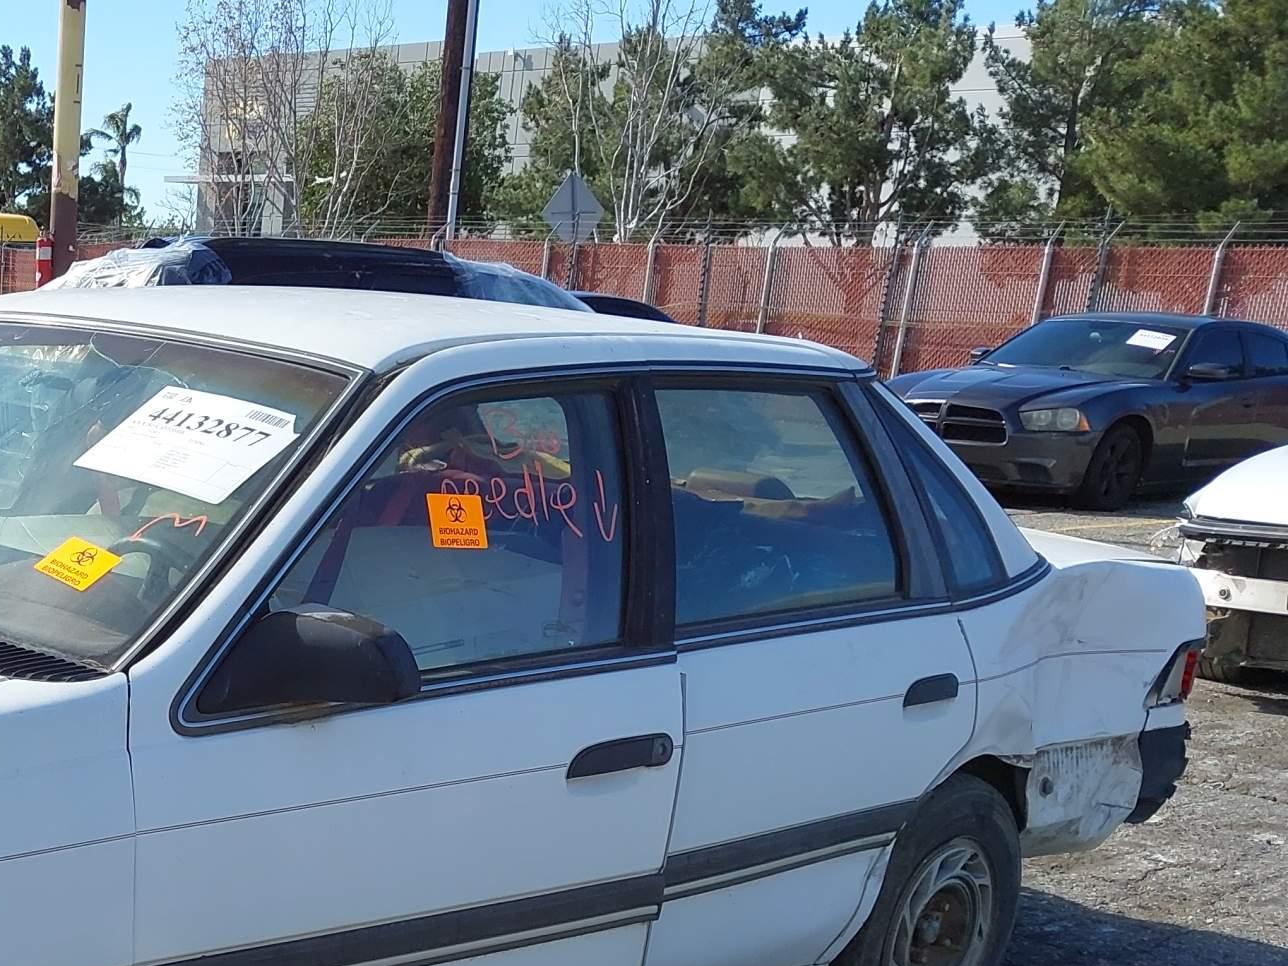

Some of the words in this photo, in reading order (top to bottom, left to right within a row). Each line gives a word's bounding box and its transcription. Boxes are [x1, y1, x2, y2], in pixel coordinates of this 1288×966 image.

[148, 407, 272, 447] 44132877
[439, 527, 479, 536] BIOHAZARD
[440, 538, 480, 546] BIOPELIGRO
[41, 564, 81, 586] BIOPELIGRO
[49, 558, 89, 580] BIOHAZARD
